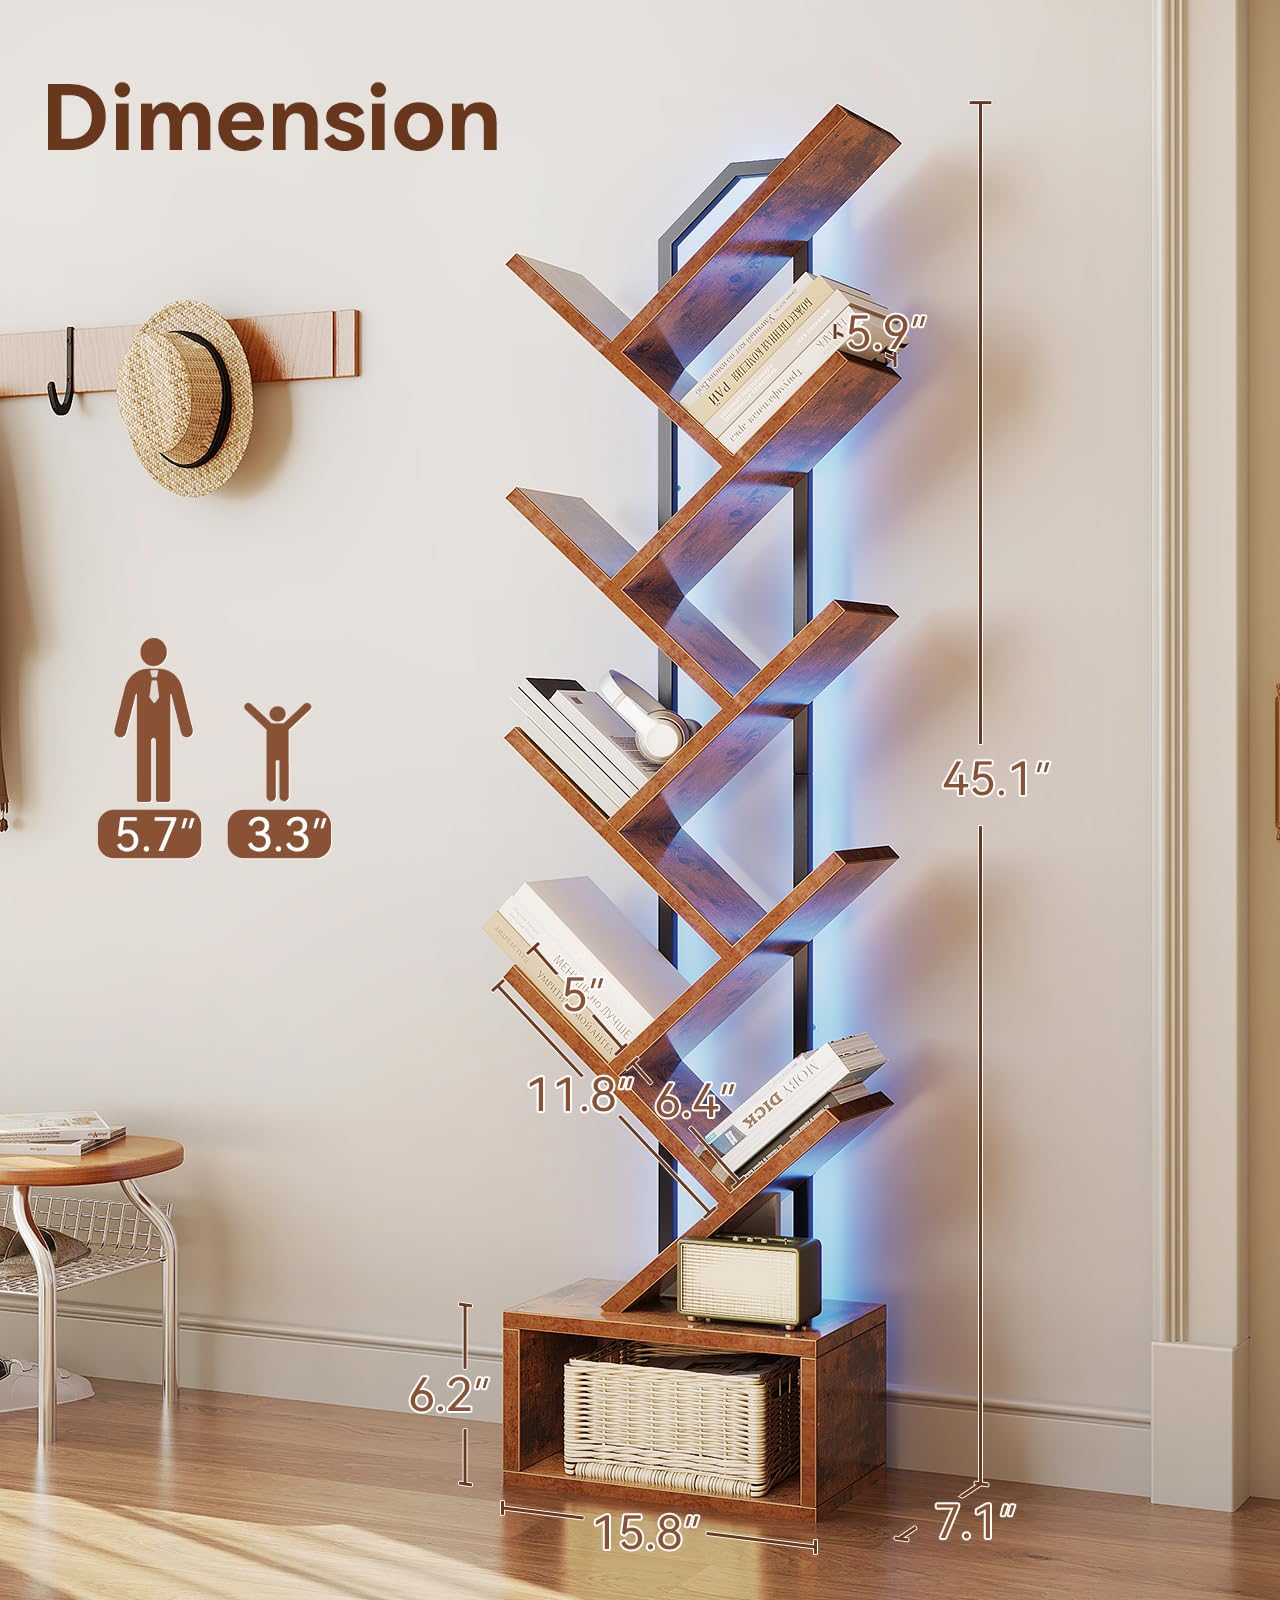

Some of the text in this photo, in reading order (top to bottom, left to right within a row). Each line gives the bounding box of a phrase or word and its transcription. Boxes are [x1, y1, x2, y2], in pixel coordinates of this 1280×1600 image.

[760, 297, 813, 352] БОЖЕСТВЕННАЯ
[730, 347, 764, 382] КОМЕДИЯ
[707, 381, 731, 407] РАЙ
[600, 1005, 632, 1039] ЛУЧШЕ
[589, 1028, 614, 1054] АНГЕЛ
[781, 1059, 821, 1095] MOBY
[742, 1092, 784, 1130] DICK
